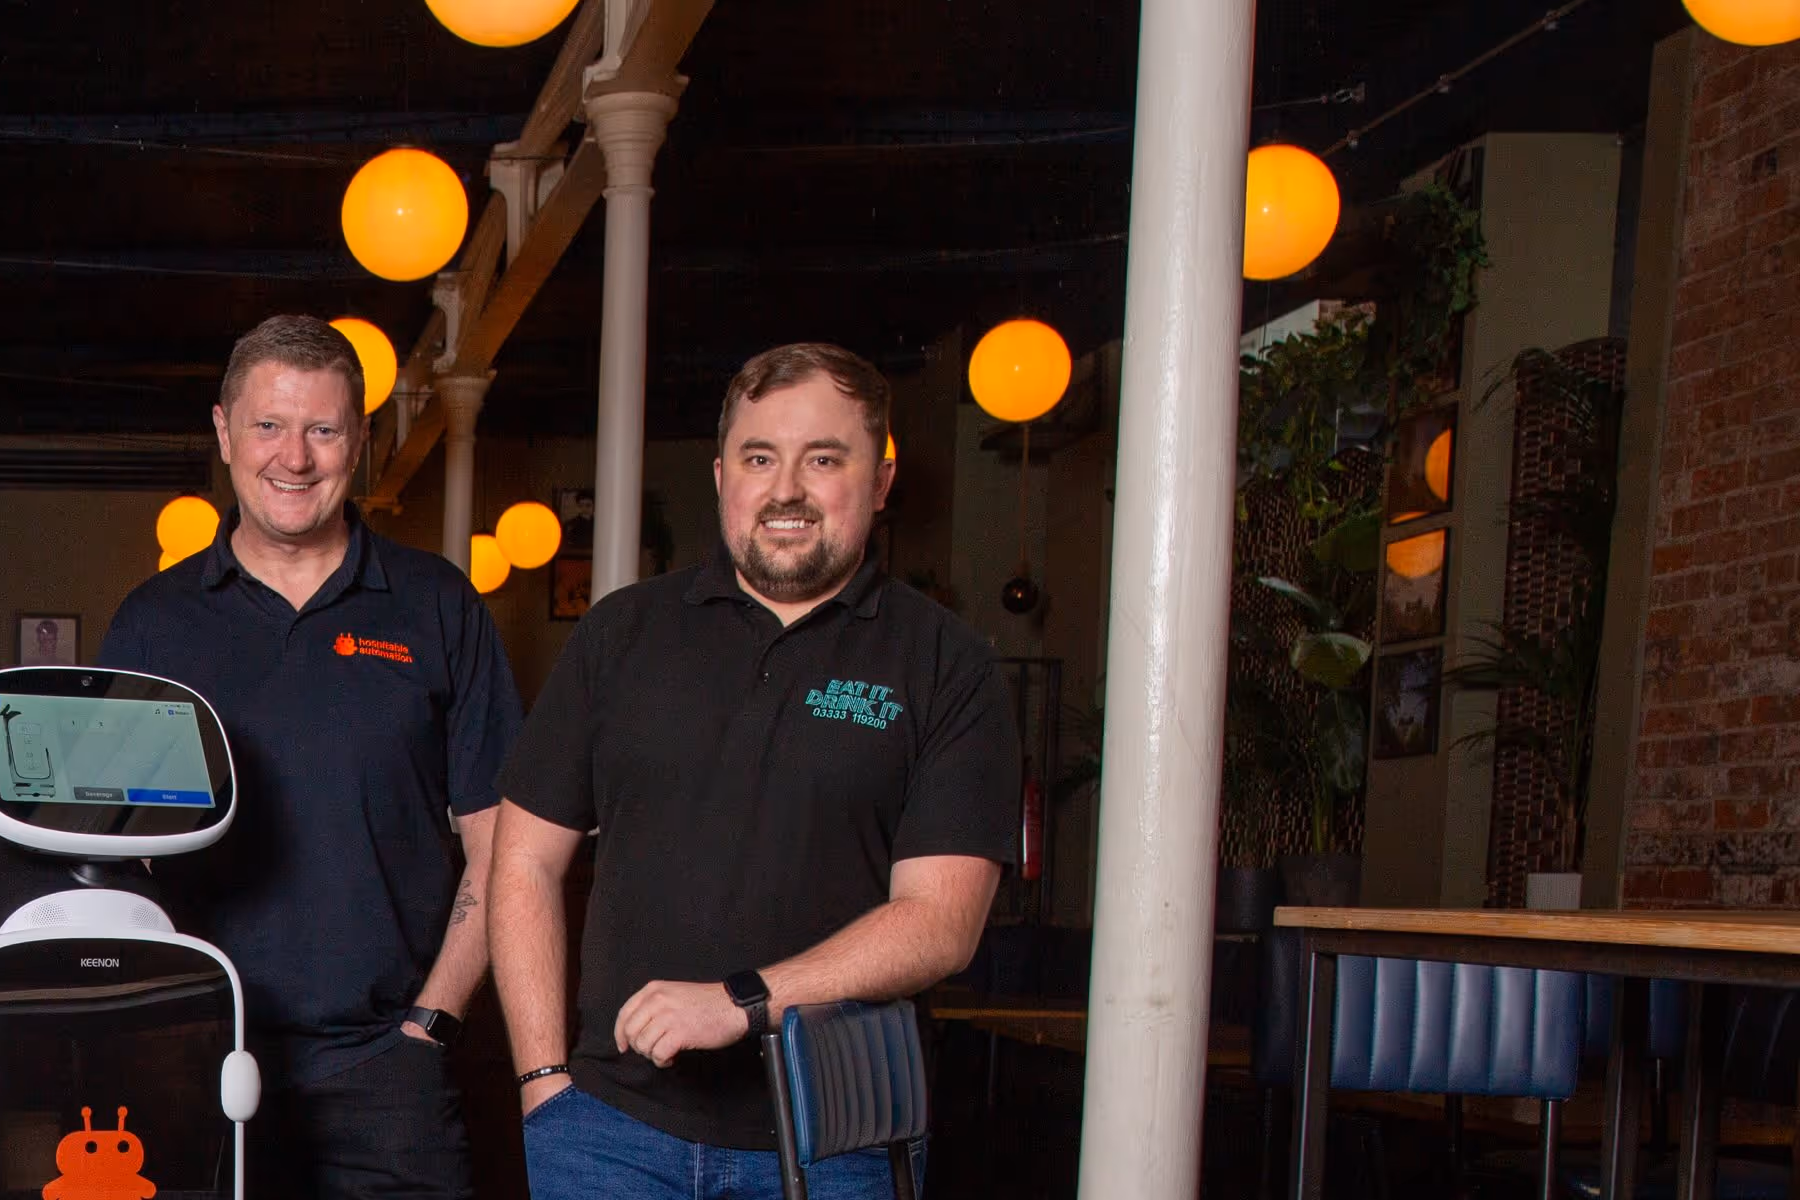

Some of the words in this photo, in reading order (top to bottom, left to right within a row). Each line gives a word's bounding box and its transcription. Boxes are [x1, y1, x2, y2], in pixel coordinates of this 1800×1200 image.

[359, 638, 409, 654] hospitable
[359, 647, 413, 663] automation
[826, 679, 869, 697] EAT
[868, 684, 894, 702] IT
[805, 688, 876, 717] DRINK
[878, 701, 904, 721] IT
[812, 707, 847, 720] 03333
[851, 713, 887, 730] 119200
[80, 958, 120, 968] KEENON
